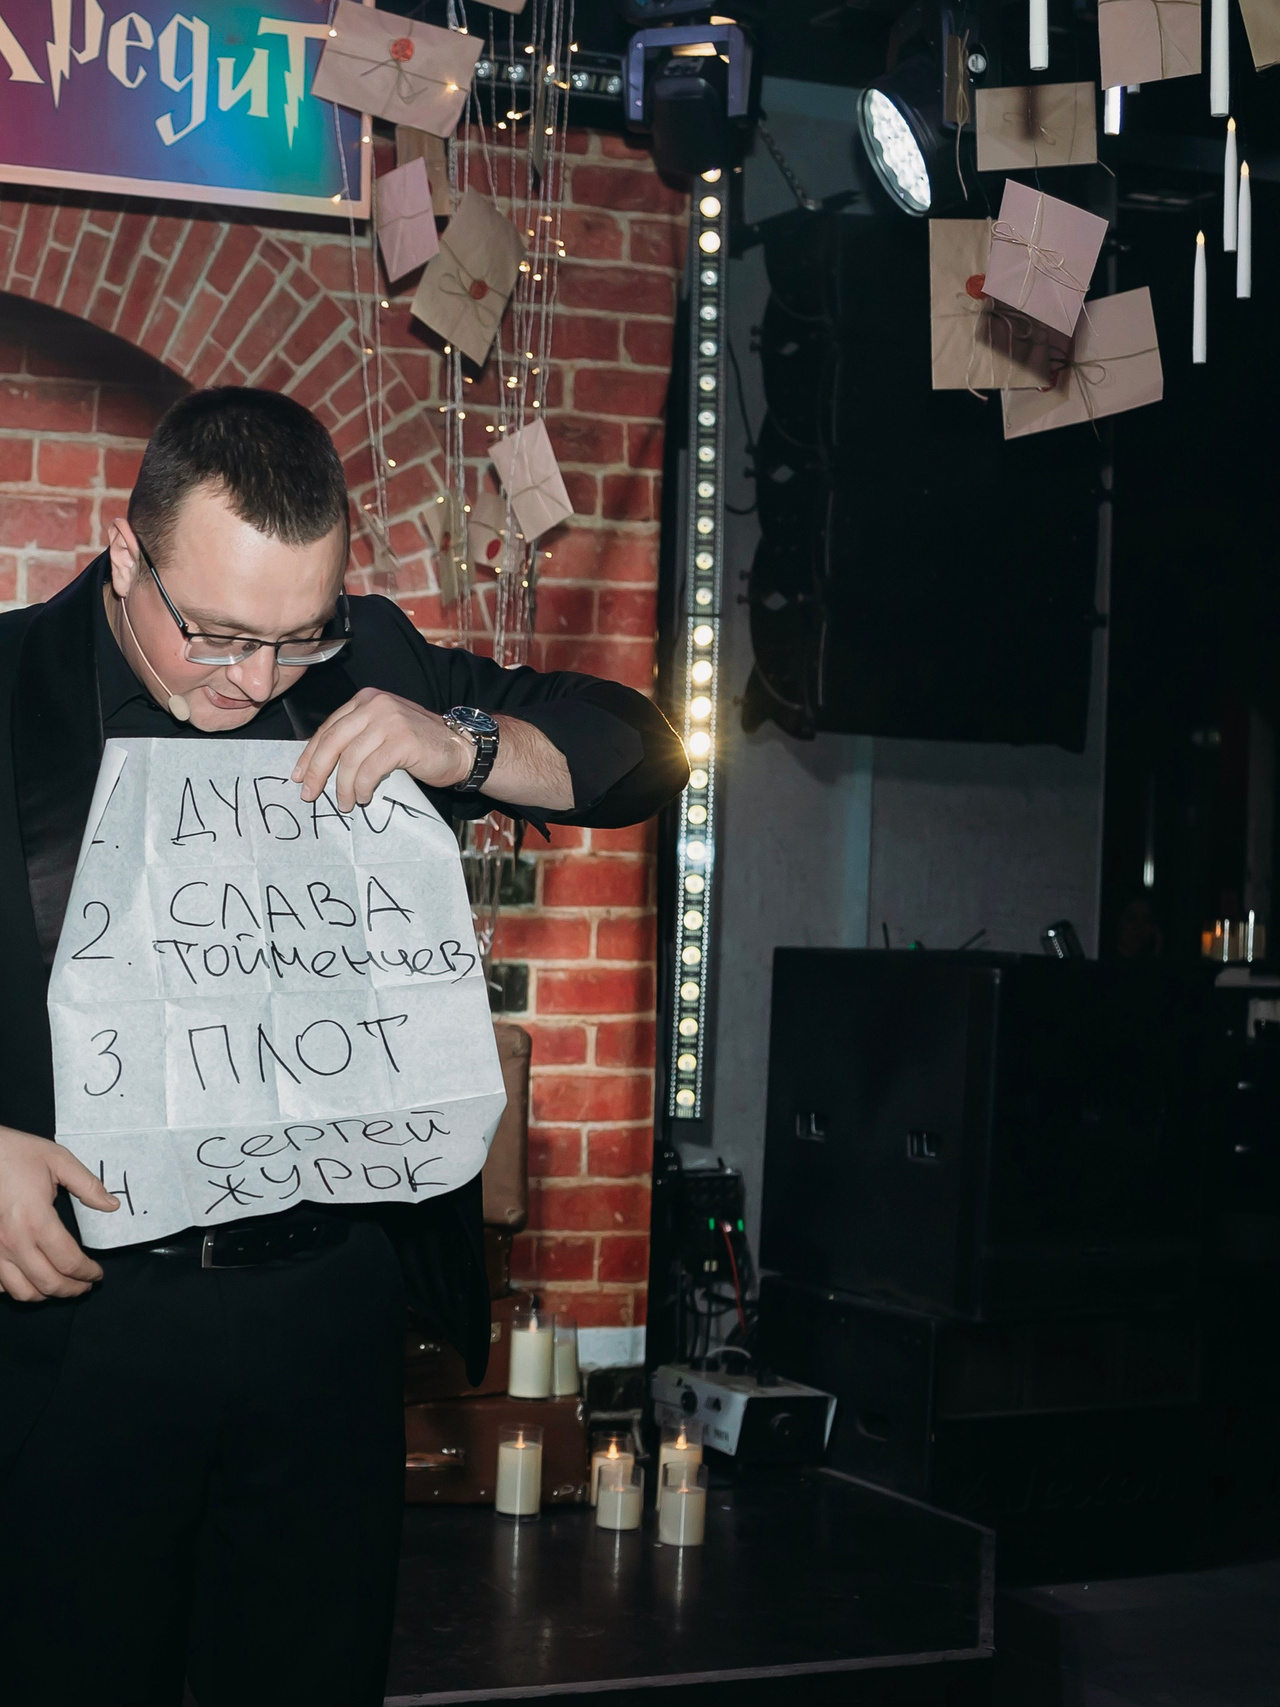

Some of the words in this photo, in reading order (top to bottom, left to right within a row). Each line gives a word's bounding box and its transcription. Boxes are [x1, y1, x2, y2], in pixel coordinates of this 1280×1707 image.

[70, 900, 133, 966] 2.
[169, 875, 415, 934] СЛАВА
[83, 1028, 125, 1098] 3.
[187, 1013, 410, 1091] ПЛОТ
